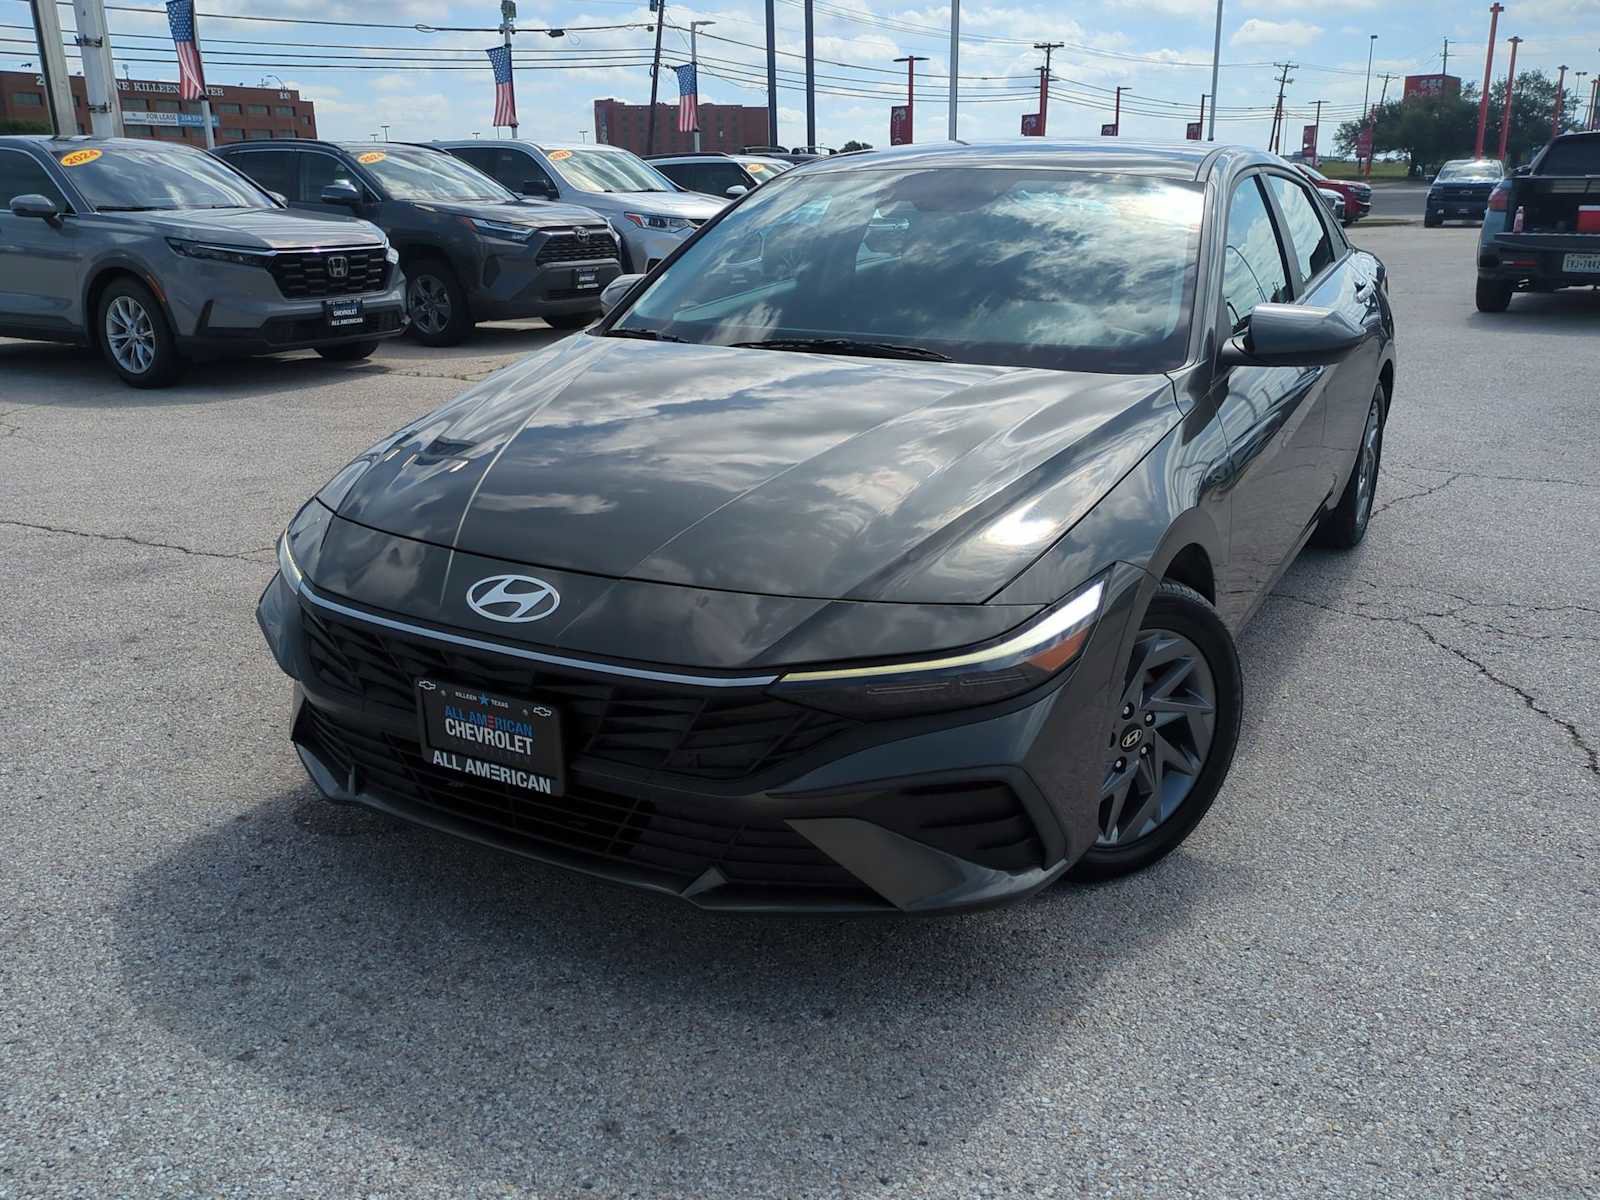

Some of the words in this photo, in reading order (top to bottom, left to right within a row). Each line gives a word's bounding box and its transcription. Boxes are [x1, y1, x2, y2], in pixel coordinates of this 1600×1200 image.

[134, 82, 180, 93] KILLEEN
[455, 691, 478, 702] KILLEEN
[490, 698, 509, 709] TEXAS
[444, 704, 469, 721] ALL
[469, 711, 533, 737] AMERICAN
[444, 718, 534, 756] CHEVROLET
[432, 750, 462, 771] ALL
[465, 758, 552, 794] AMERICAN
